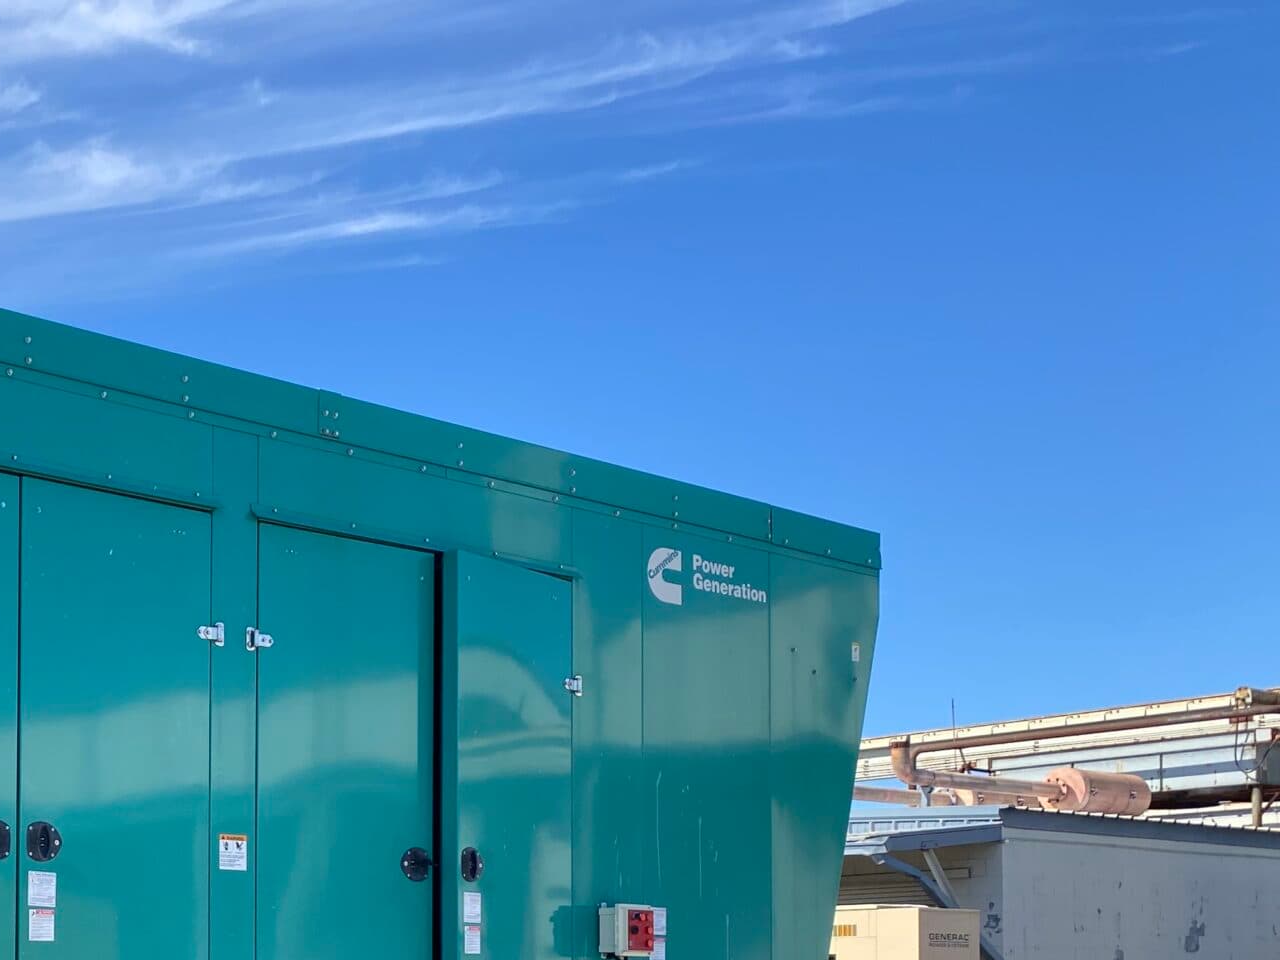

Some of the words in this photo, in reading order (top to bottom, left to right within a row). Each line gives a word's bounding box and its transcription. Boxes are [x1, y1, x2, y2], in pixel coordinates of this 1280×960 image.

[648, 550, 679, 579] Cummins
[692, 553, 735, 579] Power
[693, 572, 767, 603] Generation
[928, 932, 969, 941] GENERAC
